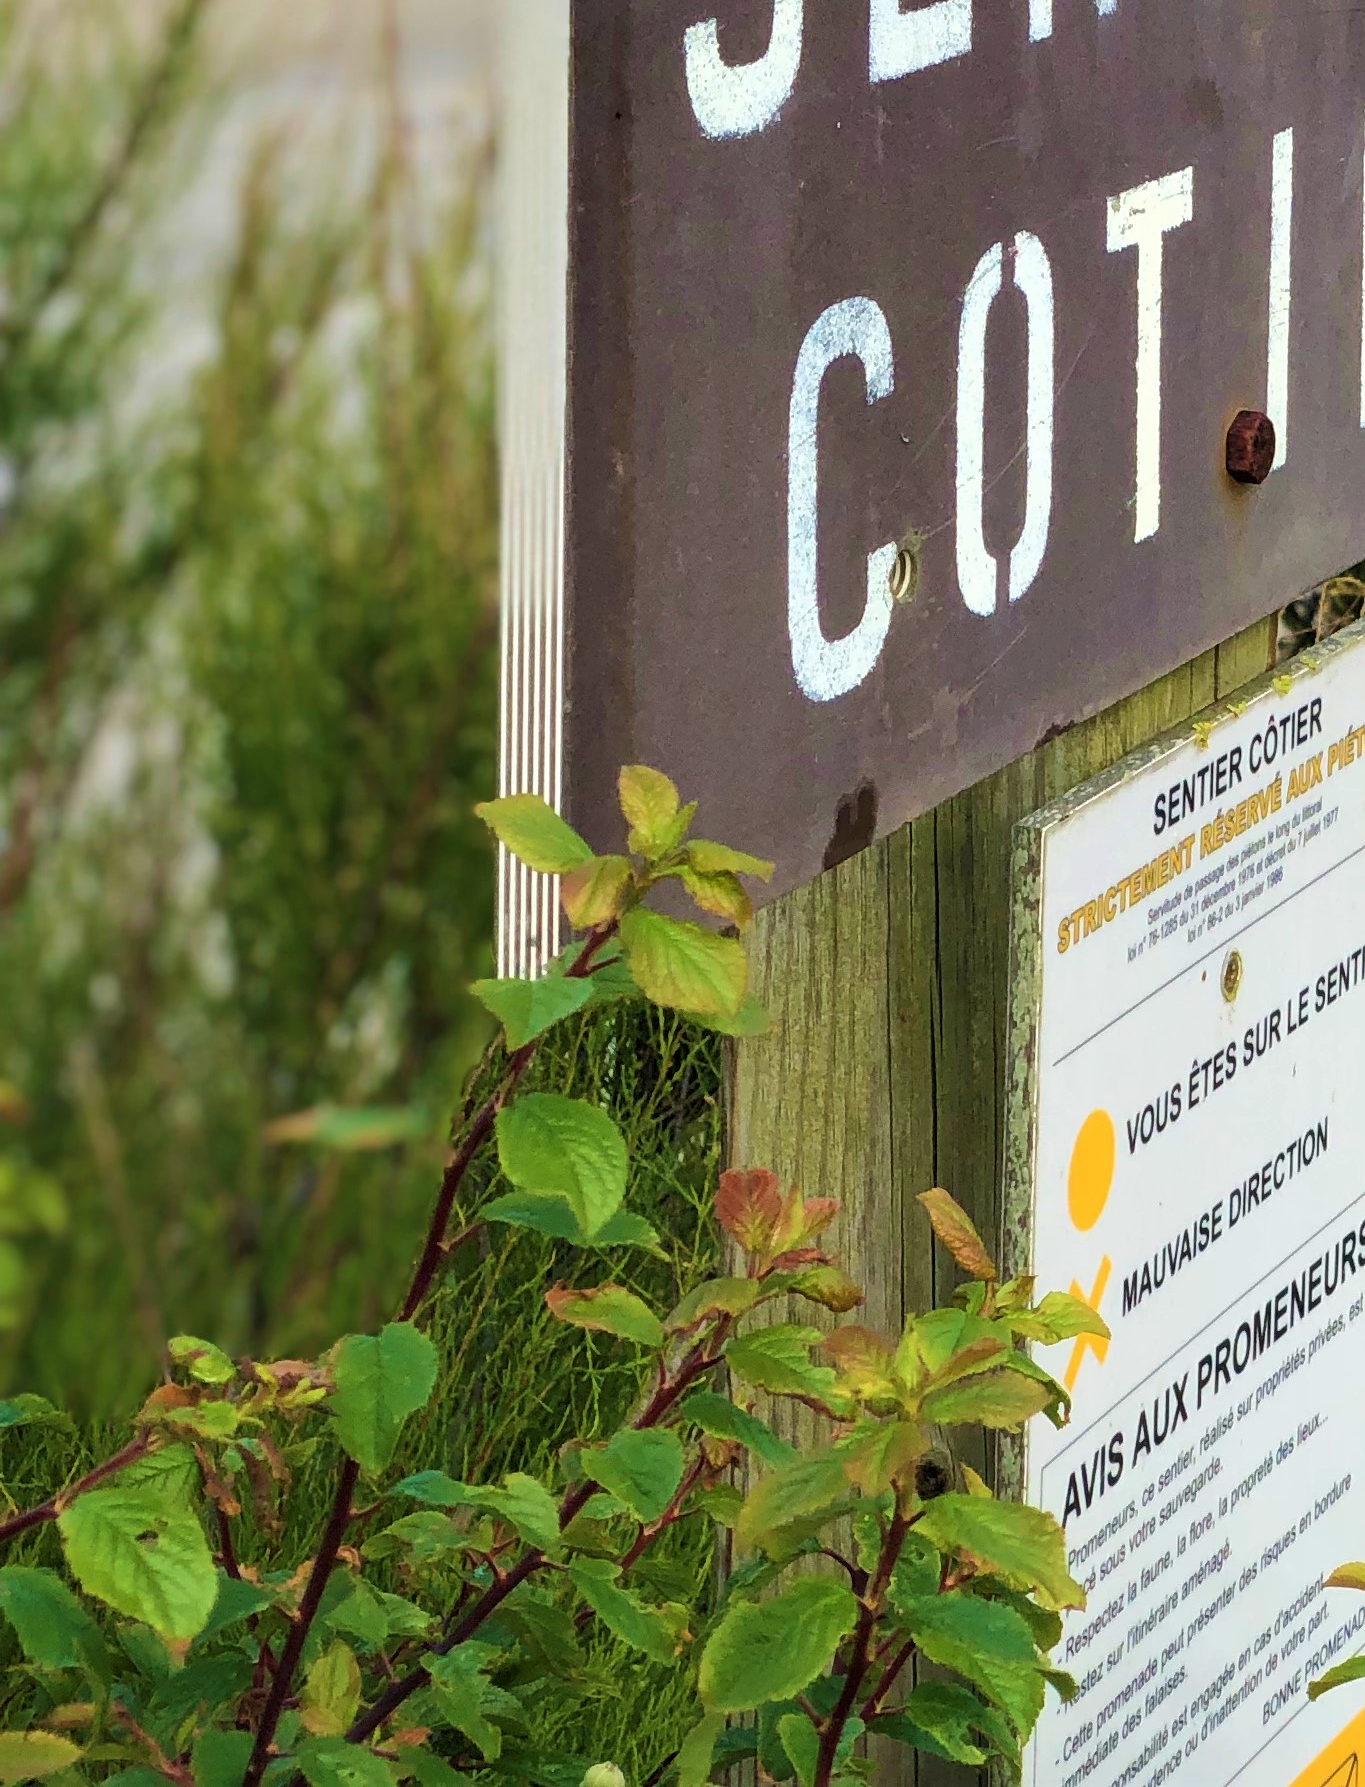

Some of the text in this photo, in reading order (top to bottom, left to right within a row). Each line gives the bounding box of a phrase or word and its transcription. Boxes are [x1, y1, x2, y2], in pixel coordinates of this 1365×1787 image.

[1153, 696, 1322, 835] SENTIER CÔTIER
[1057, 837, 1196, 954] STRICTEMENT
[1199, 776, 1282, 859] RÉSERVÉ
[1286, 760, 1323, 802] AUX
[1127, 945, 1136, 963] loi
[1180, 909, 1189, 927] du
[1190, 900, 1199, 918] 31
[1201, 878, 1235, 911] décembre
[1256, 859, 1263, 875] et
[1264, 844, 1286, 867] décret
[1287, 836, 1296, 853] du
[1303, 820, 1321, 848] juillet
[1322, 806, 1339, 831] 1977
[1147, 796, 1322, 925] Servitude de passage des piétons le long du littoral
[1187, 925, 1196, 943] loi
[1225, 900, 1234, 918] du
[1241, 881, 1265, 911] janvier
[1126, 1082, 1182, 1156] VOUS
[1188, 1041, 1237, 1111] ÊTES
[1243, 1008, 1281, 1067] SUR
[1287, 985, 1309, 1037] LE
[1121, 1115, 1329, 1318] MAUVAISE DIRECTION
[1062, 1431, 1124, 1530] AVIS
[1132, 1371, 1189, 1470] AUX
[1068, 1291, 1364, 1576] Promeneurs, ce sentier, réalisé sur propriétés privées, est
[1066, 1592, 1124, 1663] Respectez
[1127, 1581, 1137, 1605] la
[1140, 1549, 1174, 1593] faune,
[1177, 1534, 1187, 1558] la
[1189, 1511, 1215, 1546] flore,
[1218, 1495, 1228, 1519] la
[1230, 1450, 1274, 1514] propreté
[1275, 1435, 1295, 1466] des
[1099, 1543, 1126, 1582] sous
[1129, 1515, 1156, 1553] votre
[1159, 1455, 1224, 1527] sauvegarde.
[1063, 1473, 1352, 1763] Cette promenade peut présenter des risques en bordure
[1106, 1641, 1124, 1672] sur
[1127, 1590, 1179, 1653] l'itinéraire
[1181, 1537, 1233, 1602] aménagé.
[1122, 1707, 1142, 1740] des
[1144, 1664, 1189, 1718] falaises.
[1171, 1704, 1188, 1738] est
[1190, 1663, 1236, 1719] engagée
[1238, 1645, 1251, 1672] en
[1253, 1626, 1272, 1656] cas
[1184, 1731, 1199, 1758] ou
[1201, 1667, 1263, 1741] d'inattention
[1265, 1651, 1279, 1677] de
[1280, 1625, 1305, 1661] votre
[1262, 1668, 1302, 1726] BONNE
